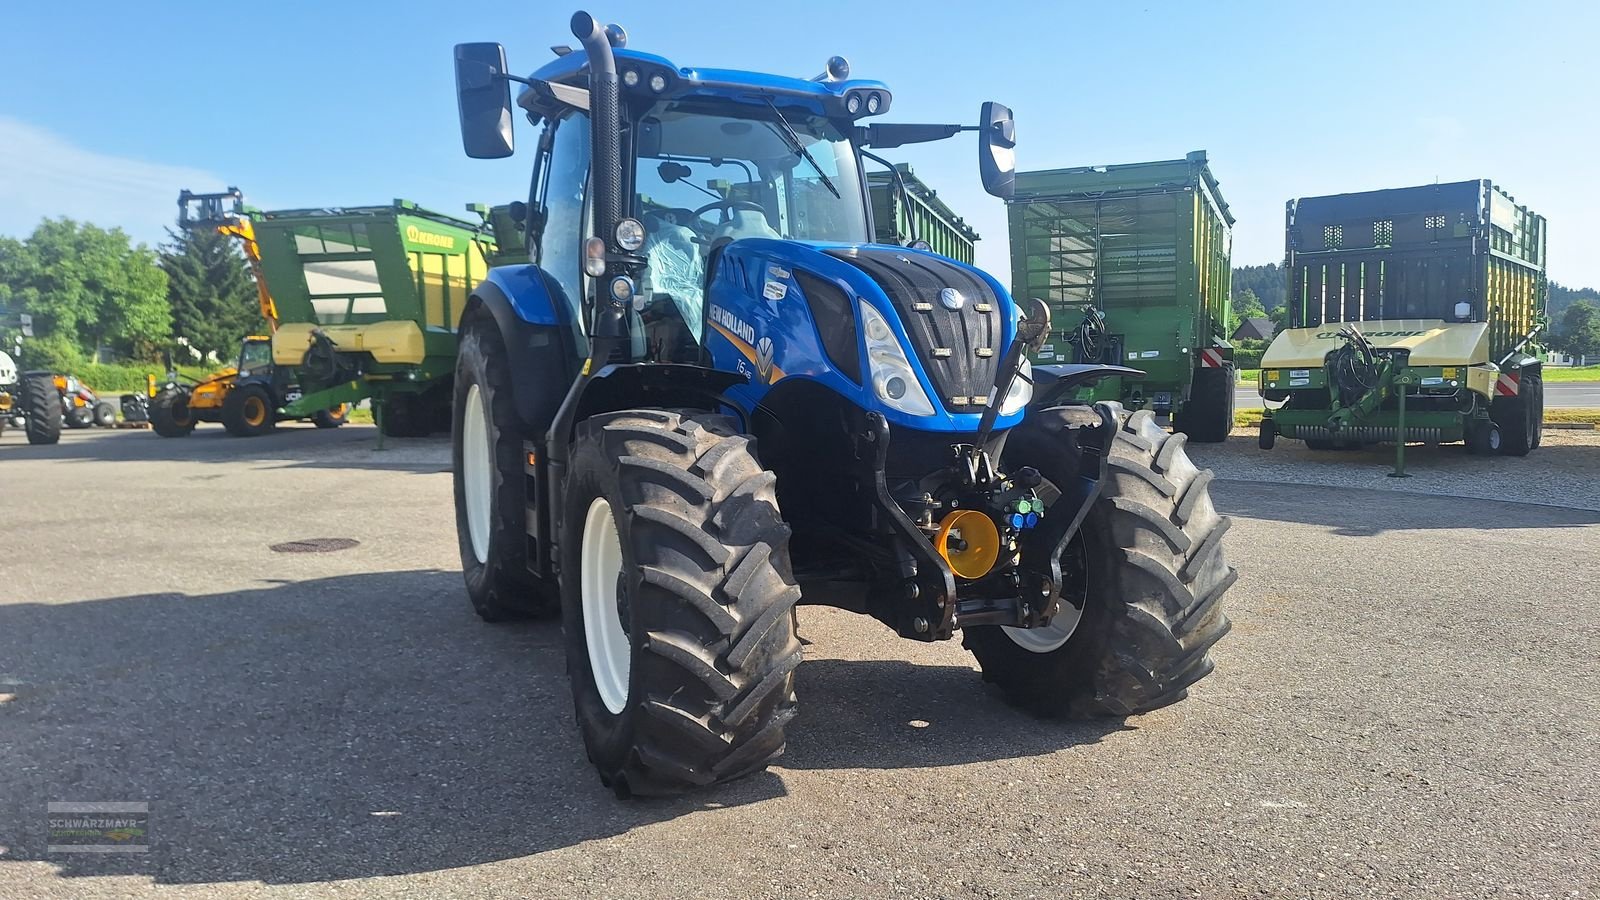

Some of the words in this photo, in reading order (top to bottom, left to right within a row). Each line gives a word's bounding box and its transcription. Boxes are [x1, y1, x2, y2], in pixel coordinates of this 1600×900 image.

[418, 231, 454, 249] KRONE
[708, 302, 723, 322] NEW
[721, 308, 755, 345] HOLLAND
